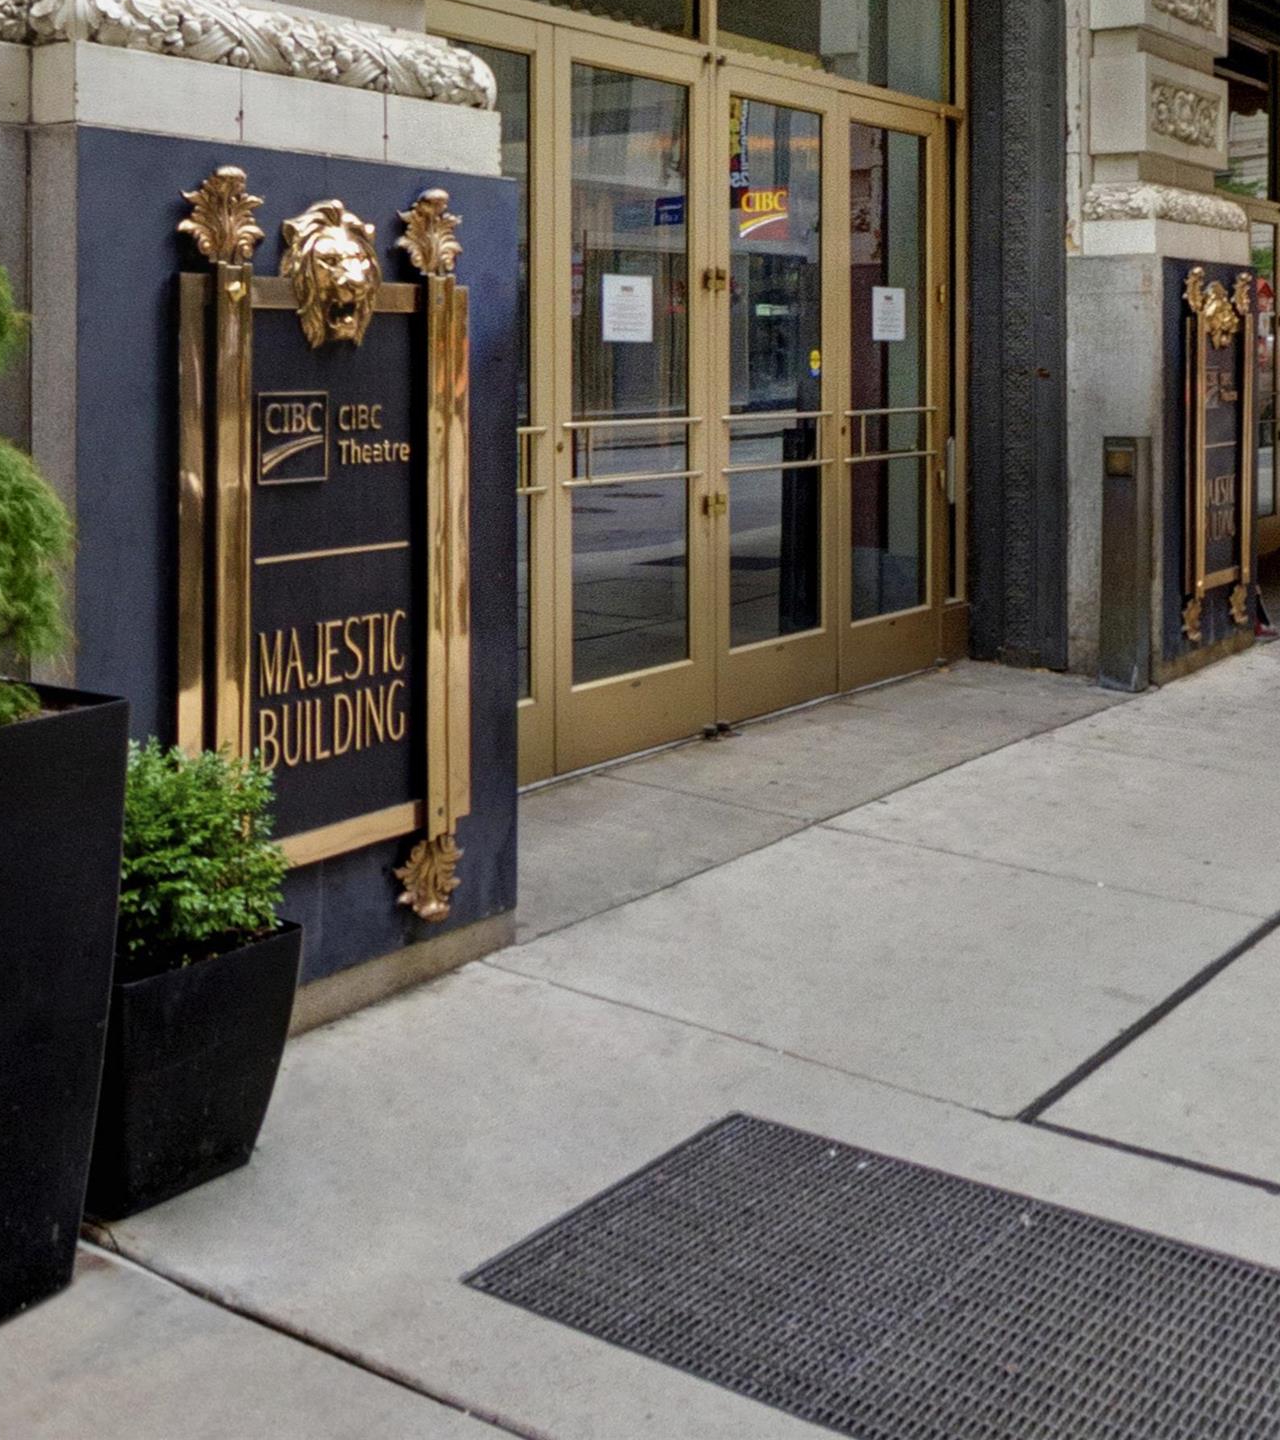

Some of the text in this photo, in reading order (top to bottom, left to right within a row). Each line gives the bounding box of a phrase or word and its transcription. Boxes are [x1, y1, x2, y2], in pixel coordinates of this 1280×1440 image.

[741, 190, 787, 214] CIBC
[264, 401, 323, 436] CIBC
[339, 403, 381, 431] CIBC
[338, 438, 411, 465] Theatre
[258, 609, 407, 698] MAJESTIC
[259, 681, 407, 772] BUILDING
